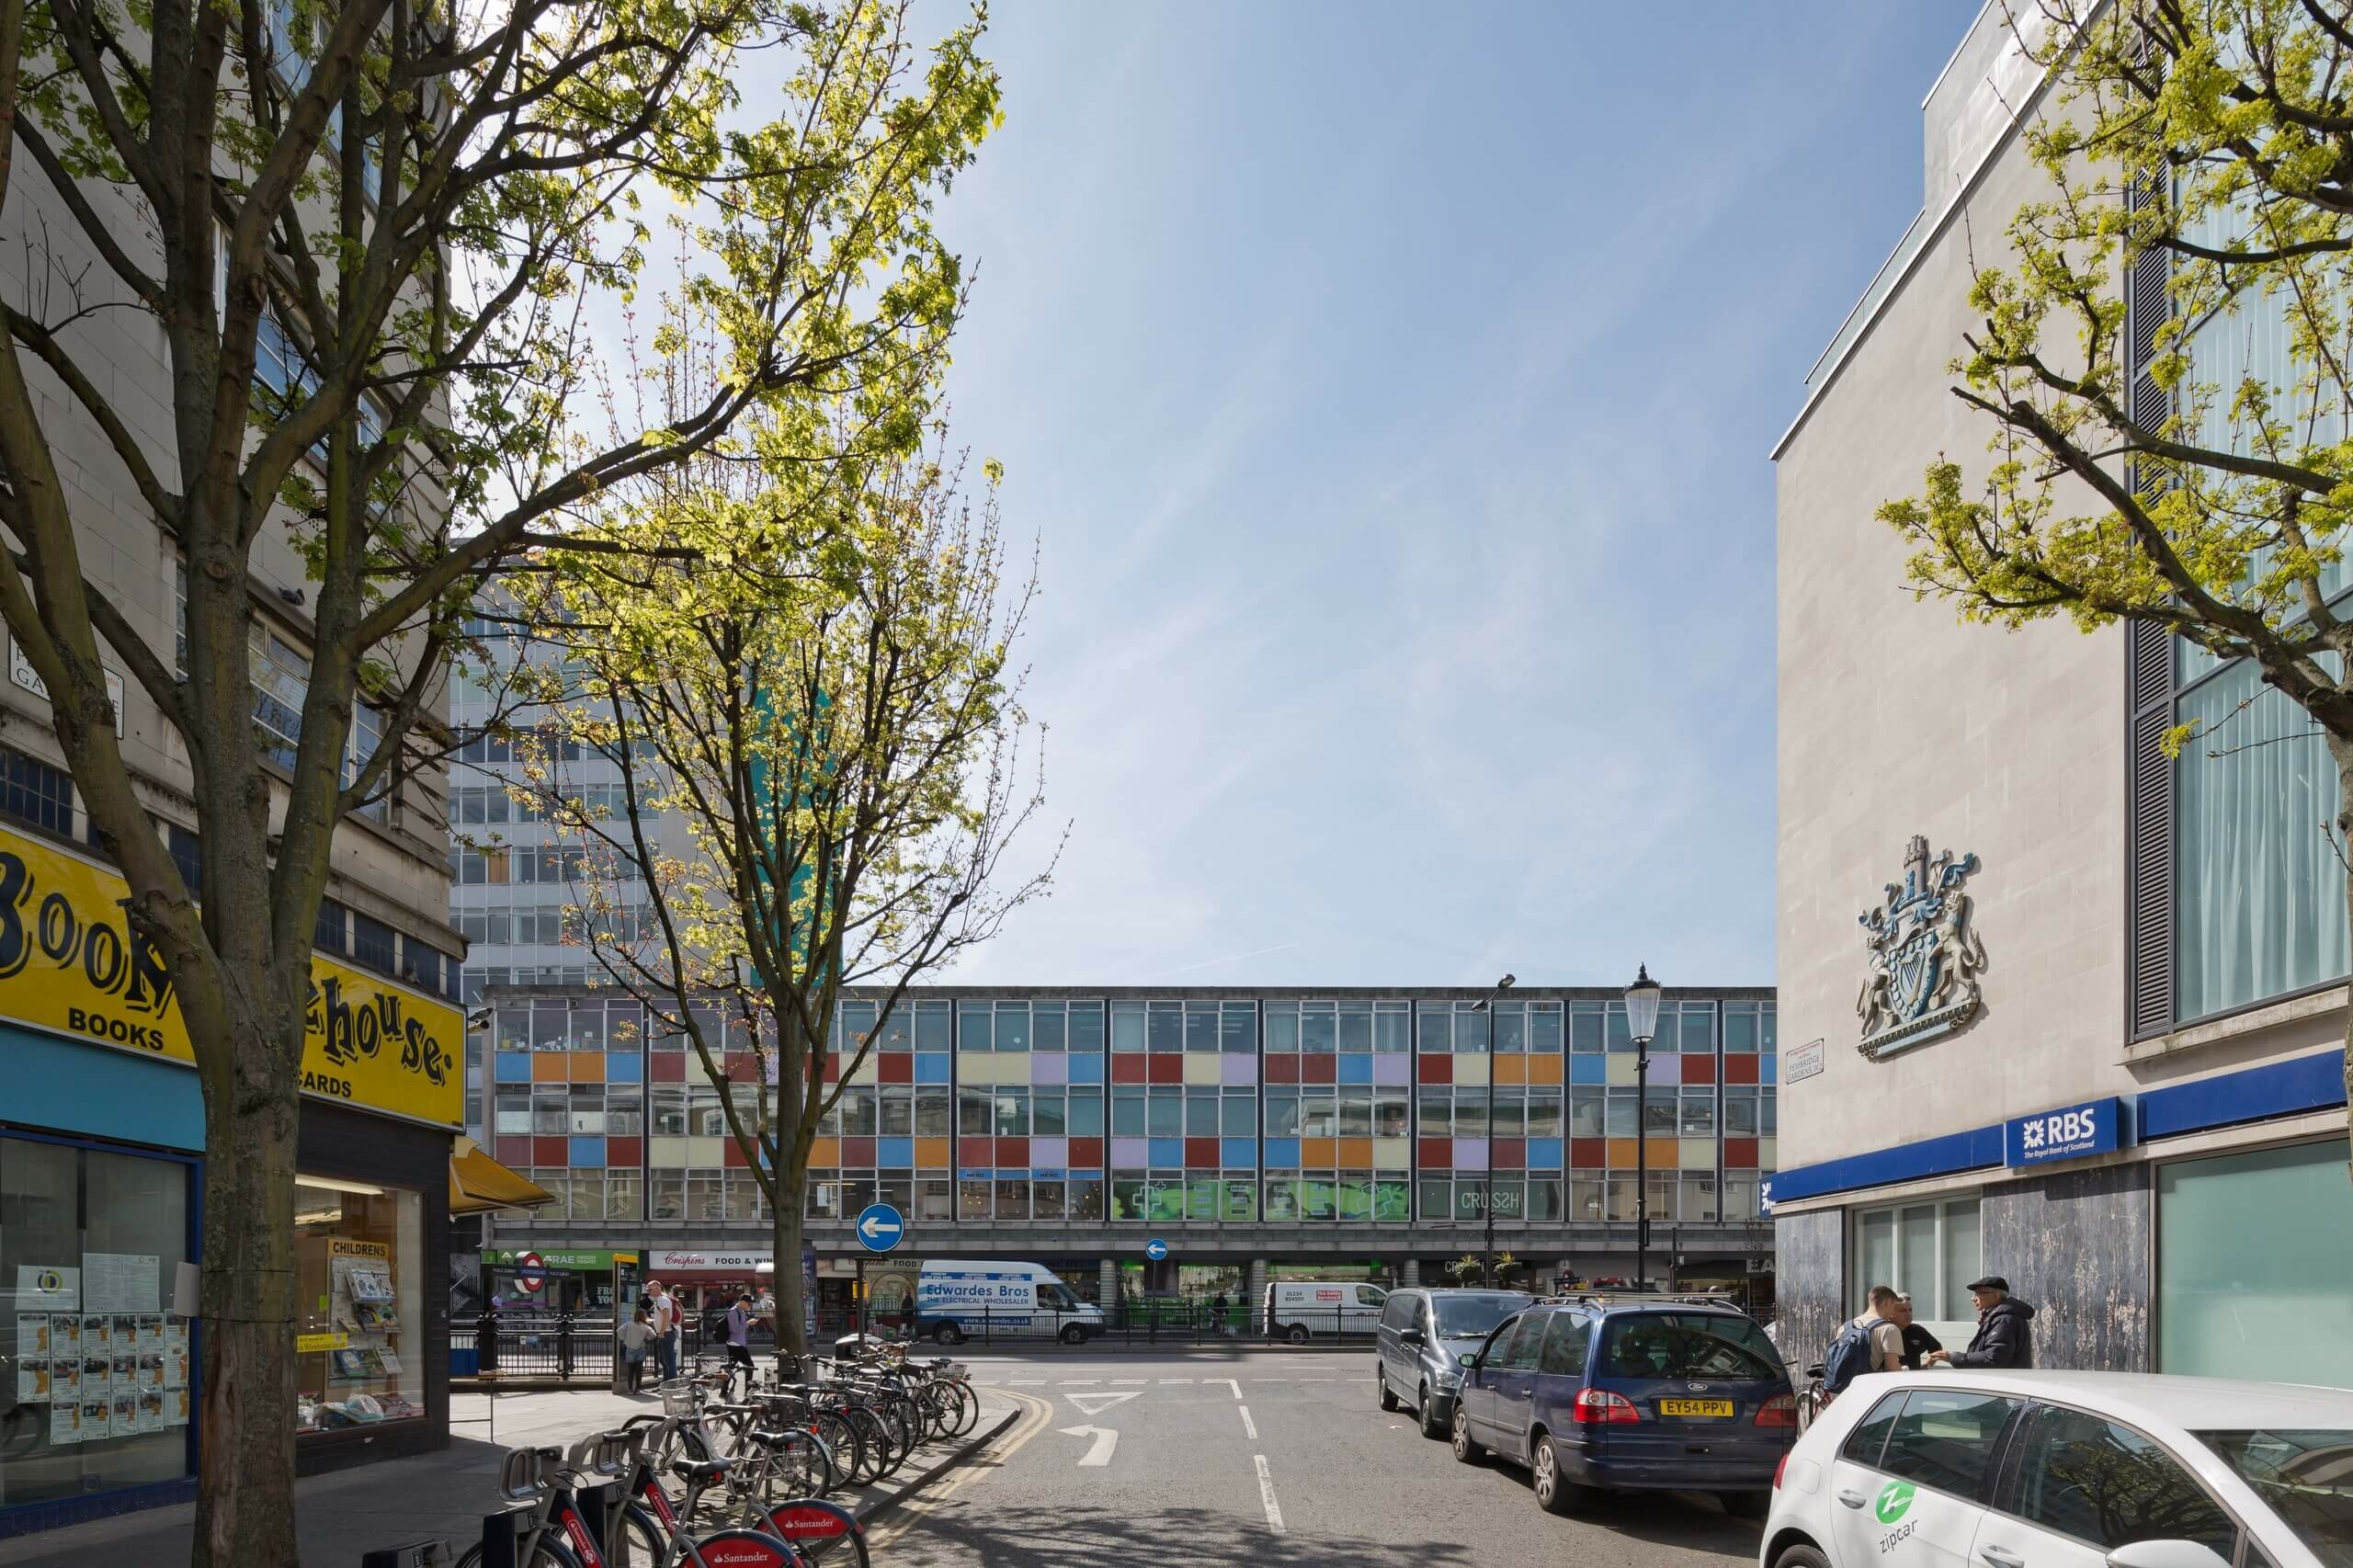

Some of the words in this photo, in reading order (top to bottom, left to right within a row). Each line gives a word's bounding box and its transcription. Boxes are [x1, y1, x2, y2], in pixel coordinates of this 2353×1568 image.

[68, 1006, 165, 1051] BOOKS
[299, 1069, 352, 1098] ARDS
[2048, 1108, 2096, 1145] RBS
[2034, 1147, 2049, 1159] Royal
[2049, 1145, 2063, 1154] Bank
[2063, 1144, 2071, 1154] of
[2070, 1139, 2095, 1152] Scotland
[333, 1242, 386, 1257] CHILDRENS
[664, 1251, 707, 1269] Crispins
[892, 1259, 917, 1267] FOOD
[926, 1284, 993, 1297] Edwardes
[999, 1285, 1029, 1298] Bros
[1666, 1402, 1699, 1414] EY54
[1702, 1402, 1727, 1414] PPV
[794, 1518, 835, 1528] Santander
[1880, 1518, 1918, 1554] zipcar
[723, 1551, 769, 1563] Santander
